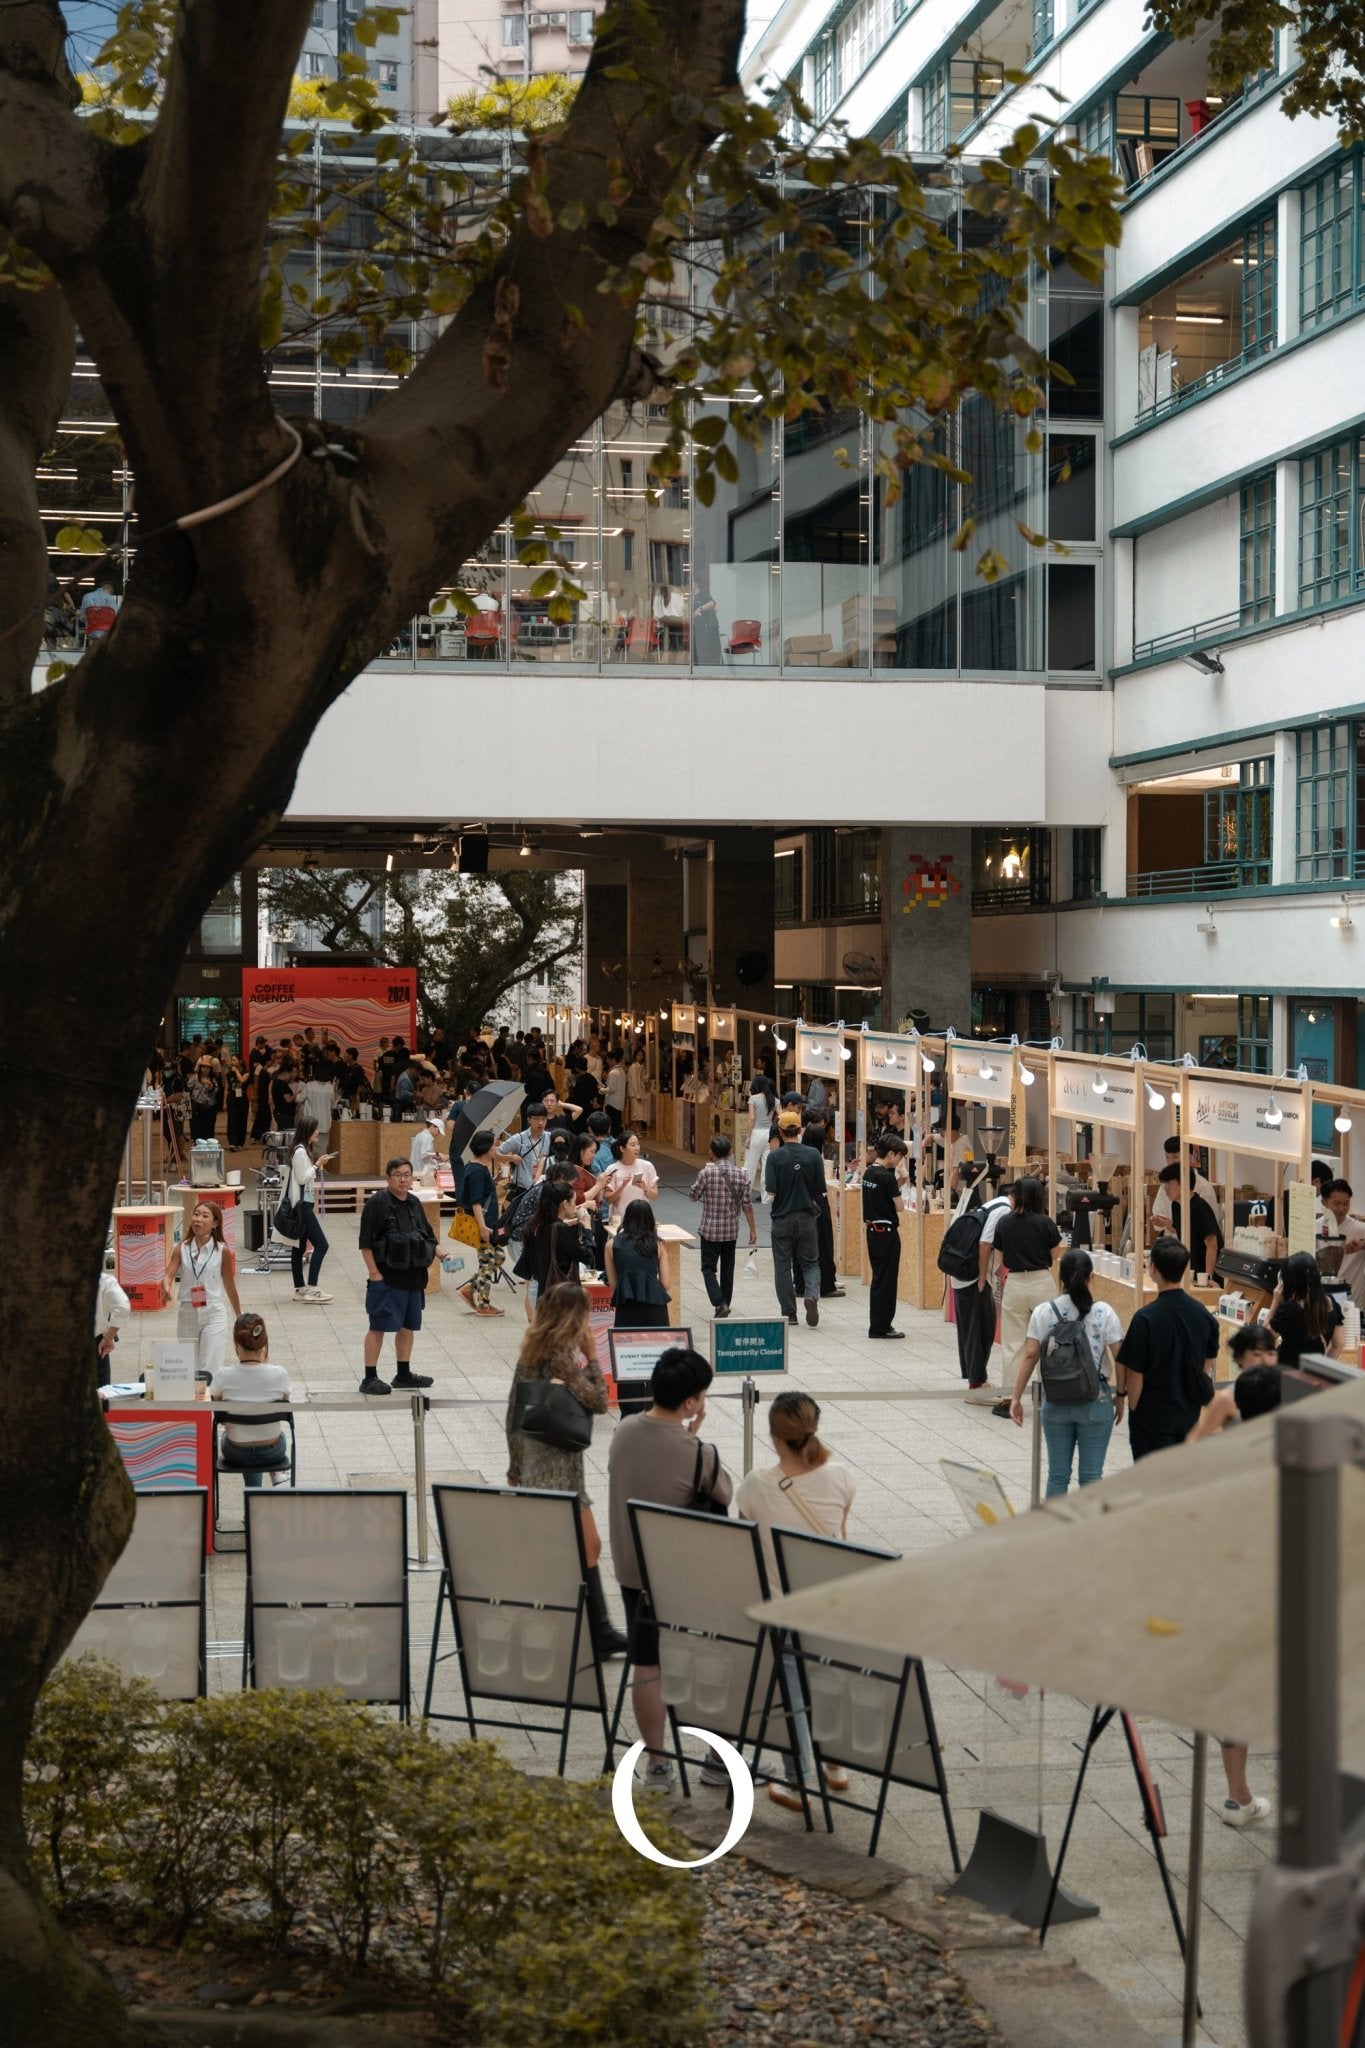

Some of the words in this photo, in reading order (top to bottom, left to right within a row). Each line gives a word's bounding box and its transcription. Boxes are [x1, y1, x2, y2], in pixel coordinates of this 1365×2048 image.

[255, 984, 295, 993] COFFEE
[249, 994, 295, 1003] AGENDA
[388, 986, 411, 1003] 2024
[717, 1348, 759, 1357] Temporarily
[759, 1347, 783, 1356] Closed
